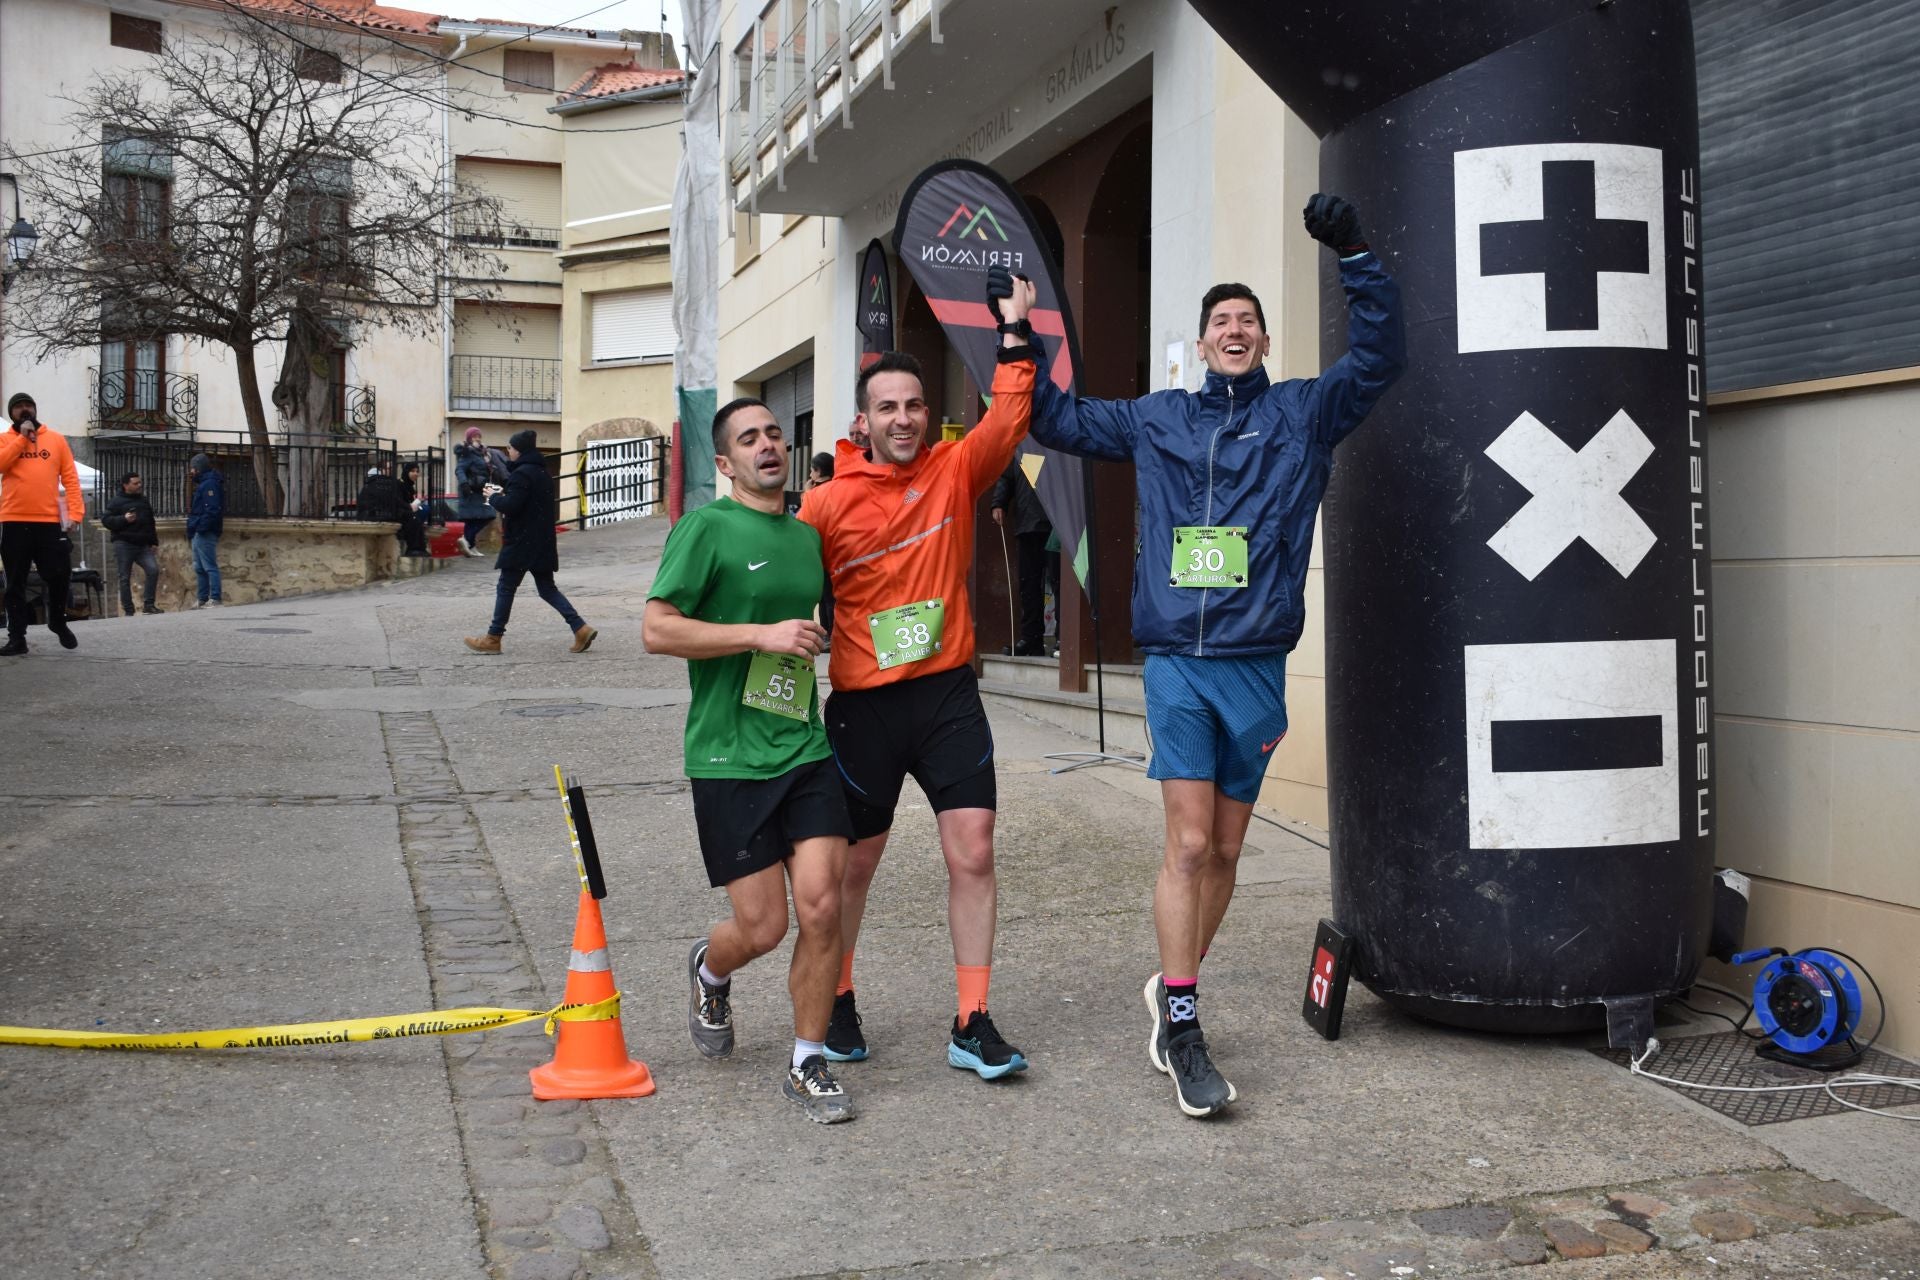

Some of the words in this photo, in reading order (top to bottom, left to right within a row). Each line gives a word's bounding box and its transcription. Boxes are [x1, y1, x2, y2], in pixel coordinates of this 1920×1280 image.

[936, 107, 1014, 164] NSISTORIAL
[1046, 23, 1126, 103] GRÁVALOS
[1681, 168, 1709, 837] maspormenos.net
[1189, 548, 1225, 572] 30
[1186, 575, 1227, 583] ARTURO
[894, 623, 931, 649] 38
[901, 647, 931, 662] JAVIER
[766, 674, 796, 701] 55
